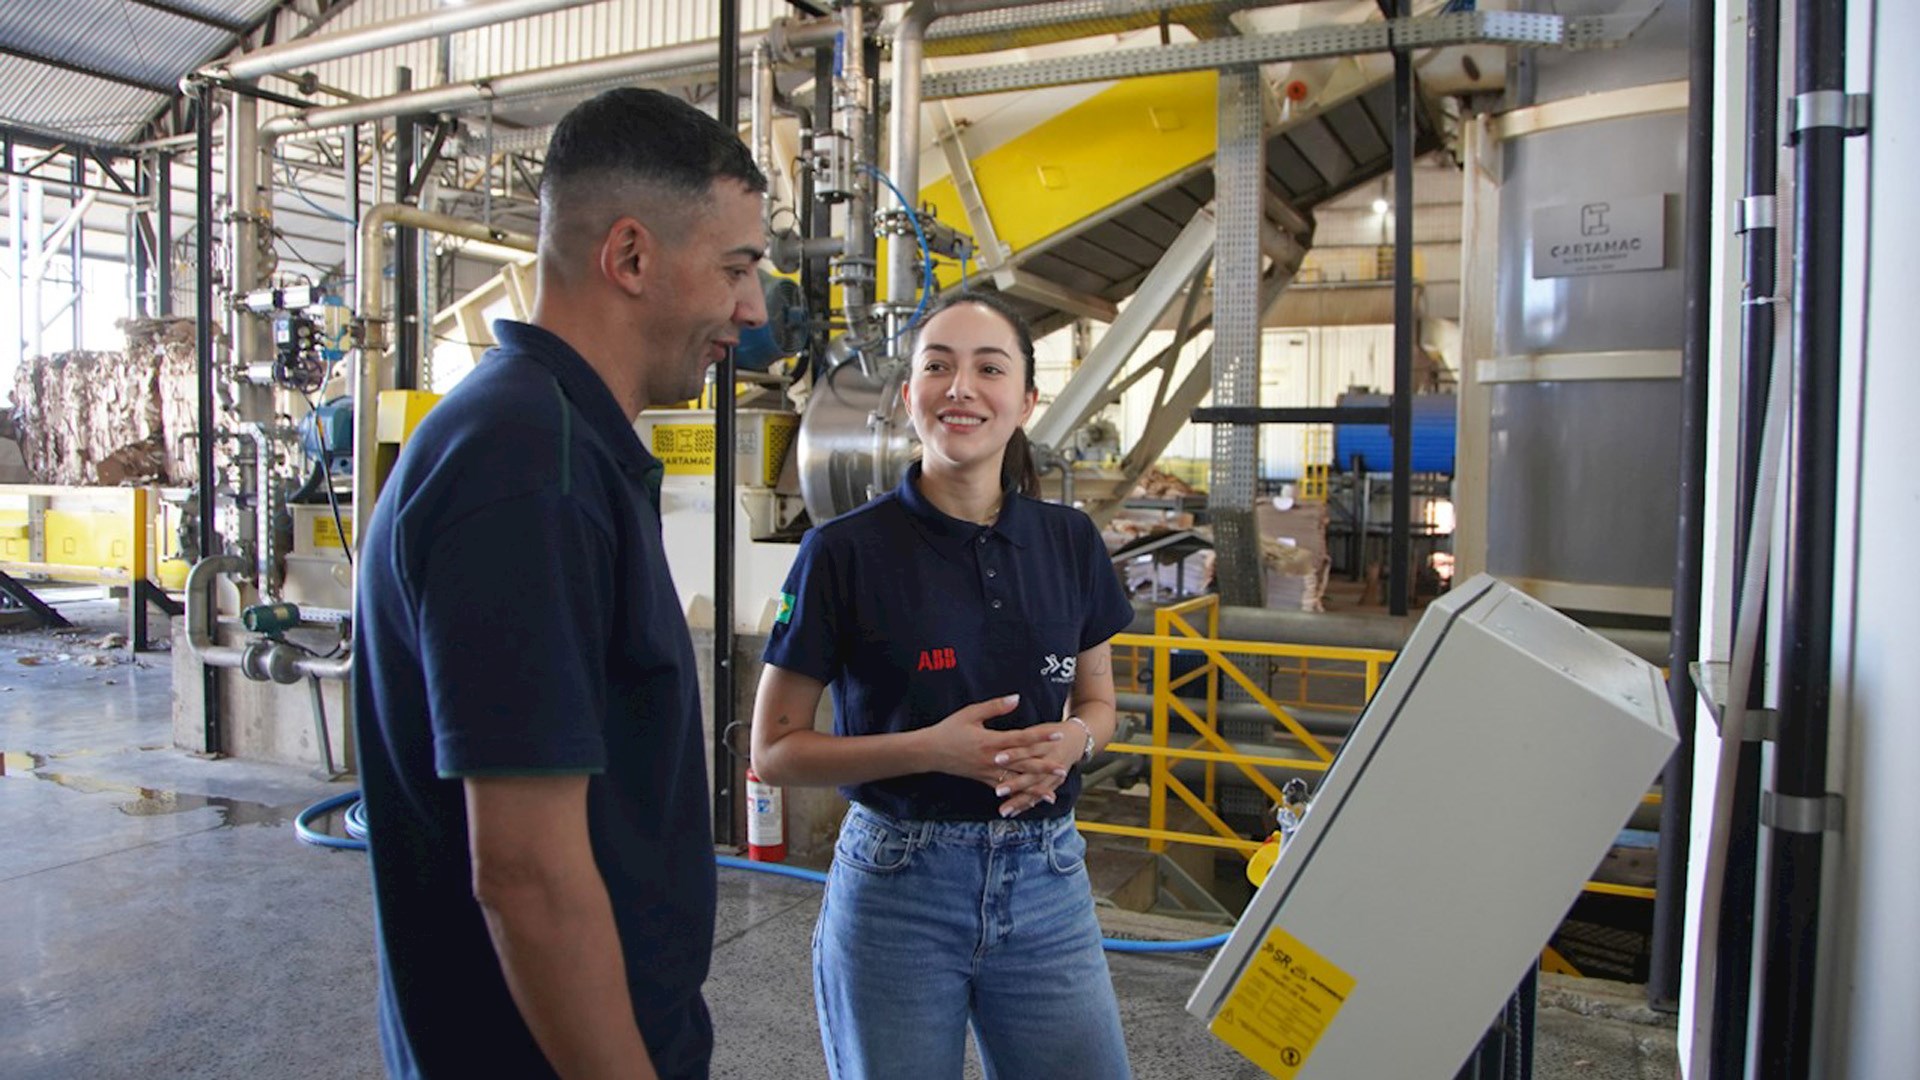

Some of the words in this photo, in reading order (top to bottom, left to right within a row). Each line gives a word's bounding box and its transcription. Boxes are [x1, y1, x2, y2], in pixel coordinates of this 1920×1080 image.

[1551, 238, 1641, 258] CARTAMAC
[918, 648, 957, 671] ABB
[1273, 949, 1292, 969] SR
